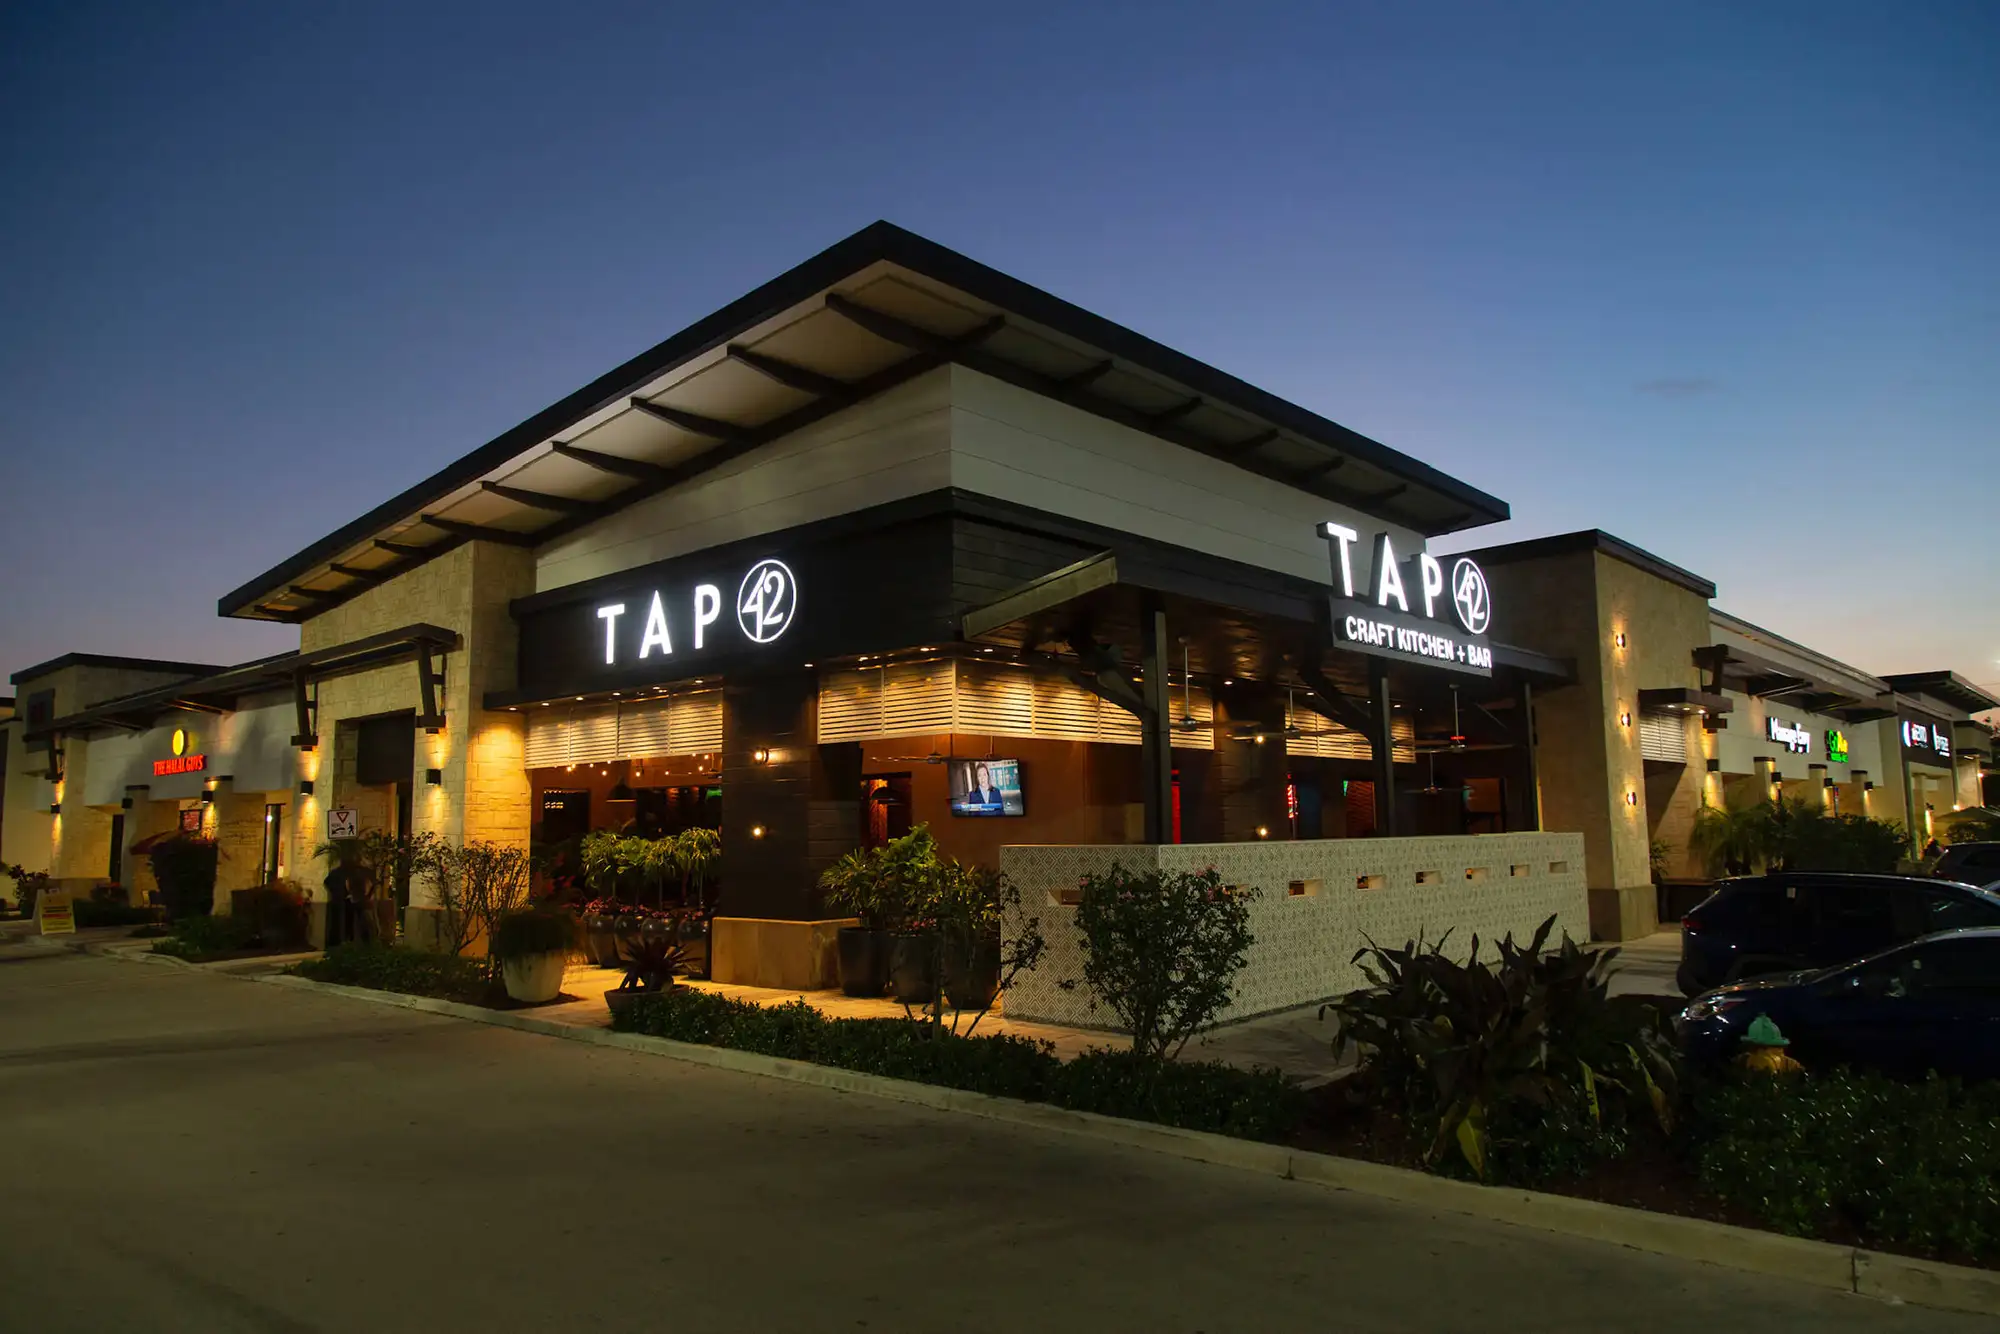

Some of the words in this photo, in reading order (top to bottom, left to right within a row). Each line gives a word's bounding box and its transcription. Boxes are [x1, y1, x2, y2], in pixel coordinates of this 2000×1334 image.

[1326, 521, 1443, 619] TAP
[1455, 562, 1487, 631] 42
[596, 583, 721, 665] TAP
[740, 565, 788, 641] 42
[1345, 615, 1395, 648] CRAFT
[1397, 626, 1455, 661] KITCHEN
[1456, 647, 1466, 663] +
[1468, 645, 1493, 669] BAR
[154, 761, 166, 776] THE
[186, 754, 203, 770] GUYS
